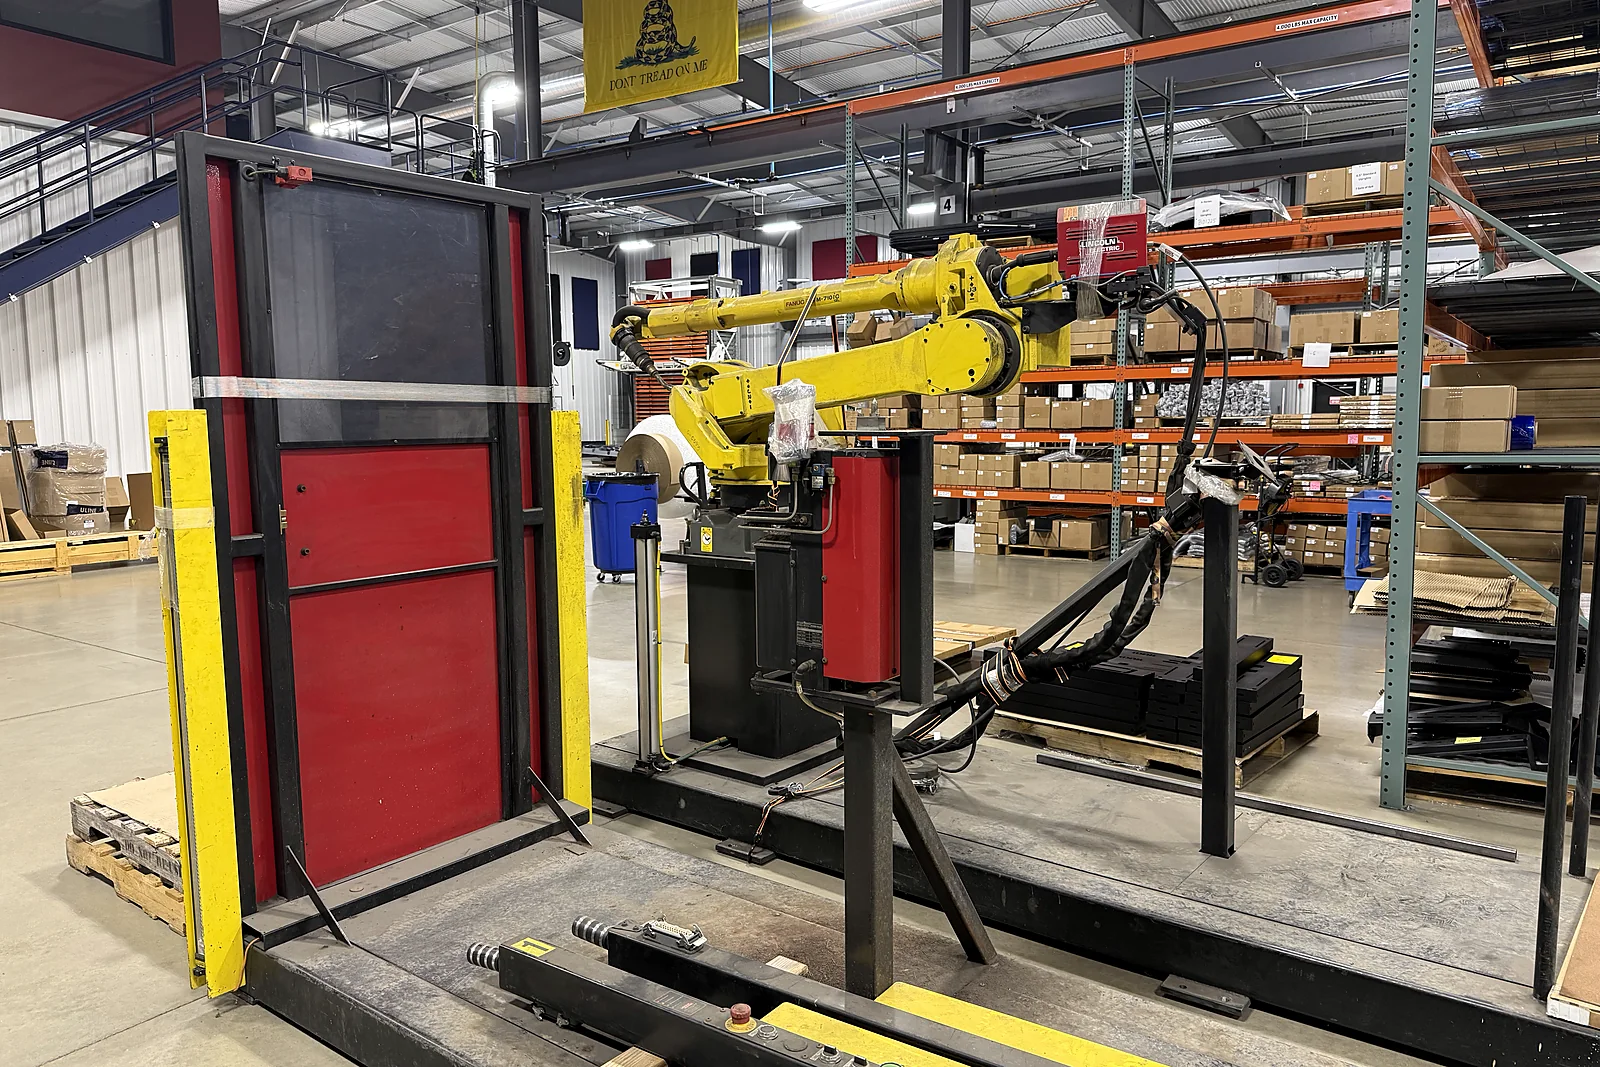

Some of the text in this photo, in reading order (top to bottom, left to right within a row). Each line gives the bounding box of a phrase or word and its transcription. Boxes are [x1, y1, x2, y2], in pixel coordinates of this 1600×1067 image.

[1313, 14, 1338, 24] CAPACITY
[609, 58, 709, 92] DONT TREAD ON ME
[943, 198, 952, 212] 4
[1080, 238, 1117, 249] LINCOLN
[785, 299, 805, 308] FANUC
[521, 940, 549, 952] 1
